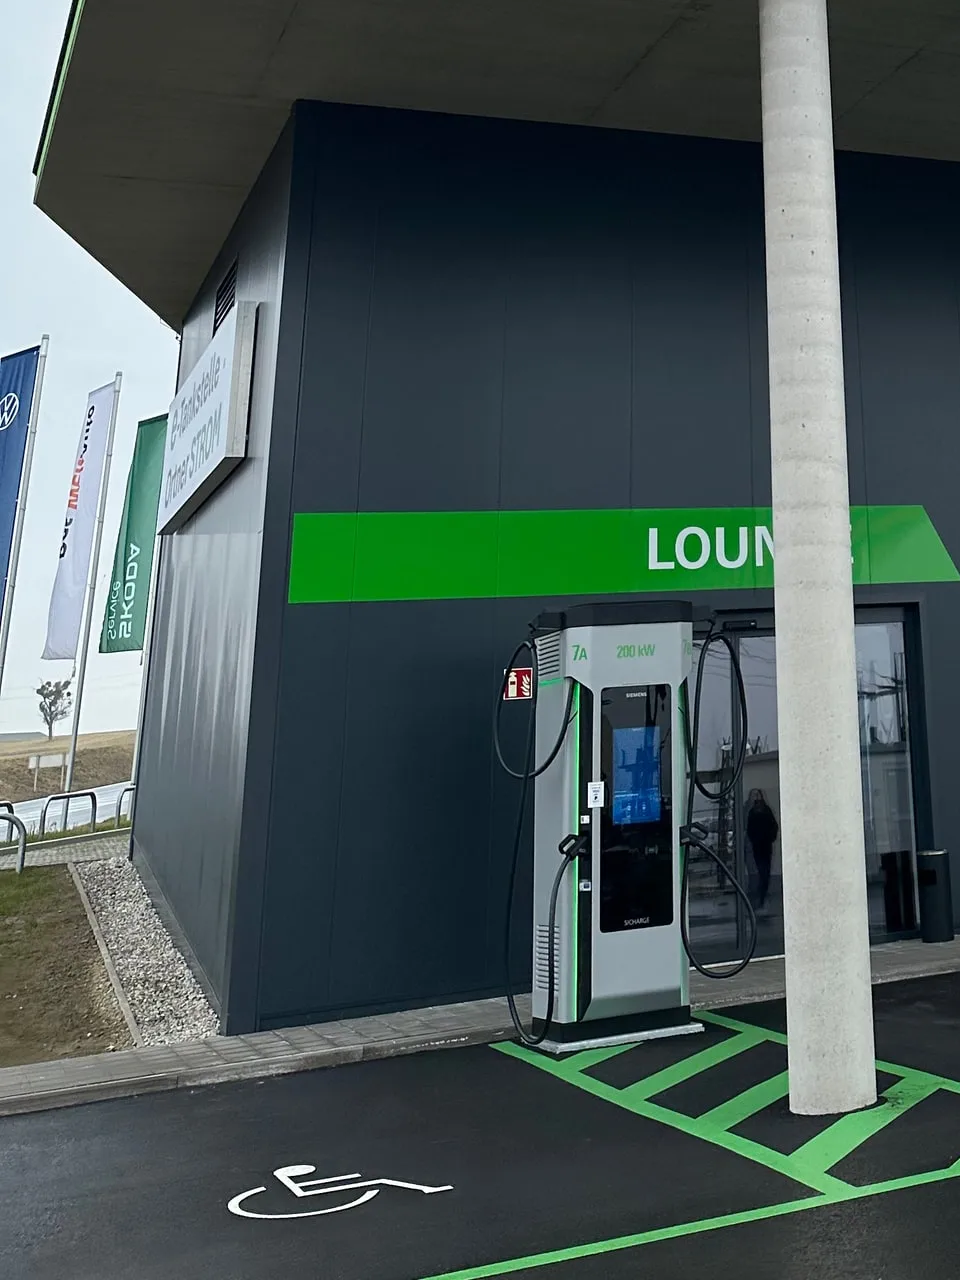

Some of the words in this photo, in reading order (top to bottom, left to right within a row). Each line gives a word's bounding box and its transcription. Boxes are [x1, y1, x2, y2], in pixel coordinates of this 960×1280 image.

[164, 454, 190, 509] Ortner
[189, 401, 222, 478] STROM
[648, 524, 854, 570] LOUN
[572, 644, 587, 661] 7A
[616, 645, 635, 659] 200
[638, 643, 656, 657] kW
[626, 691, 647, 699] SIEMENS
